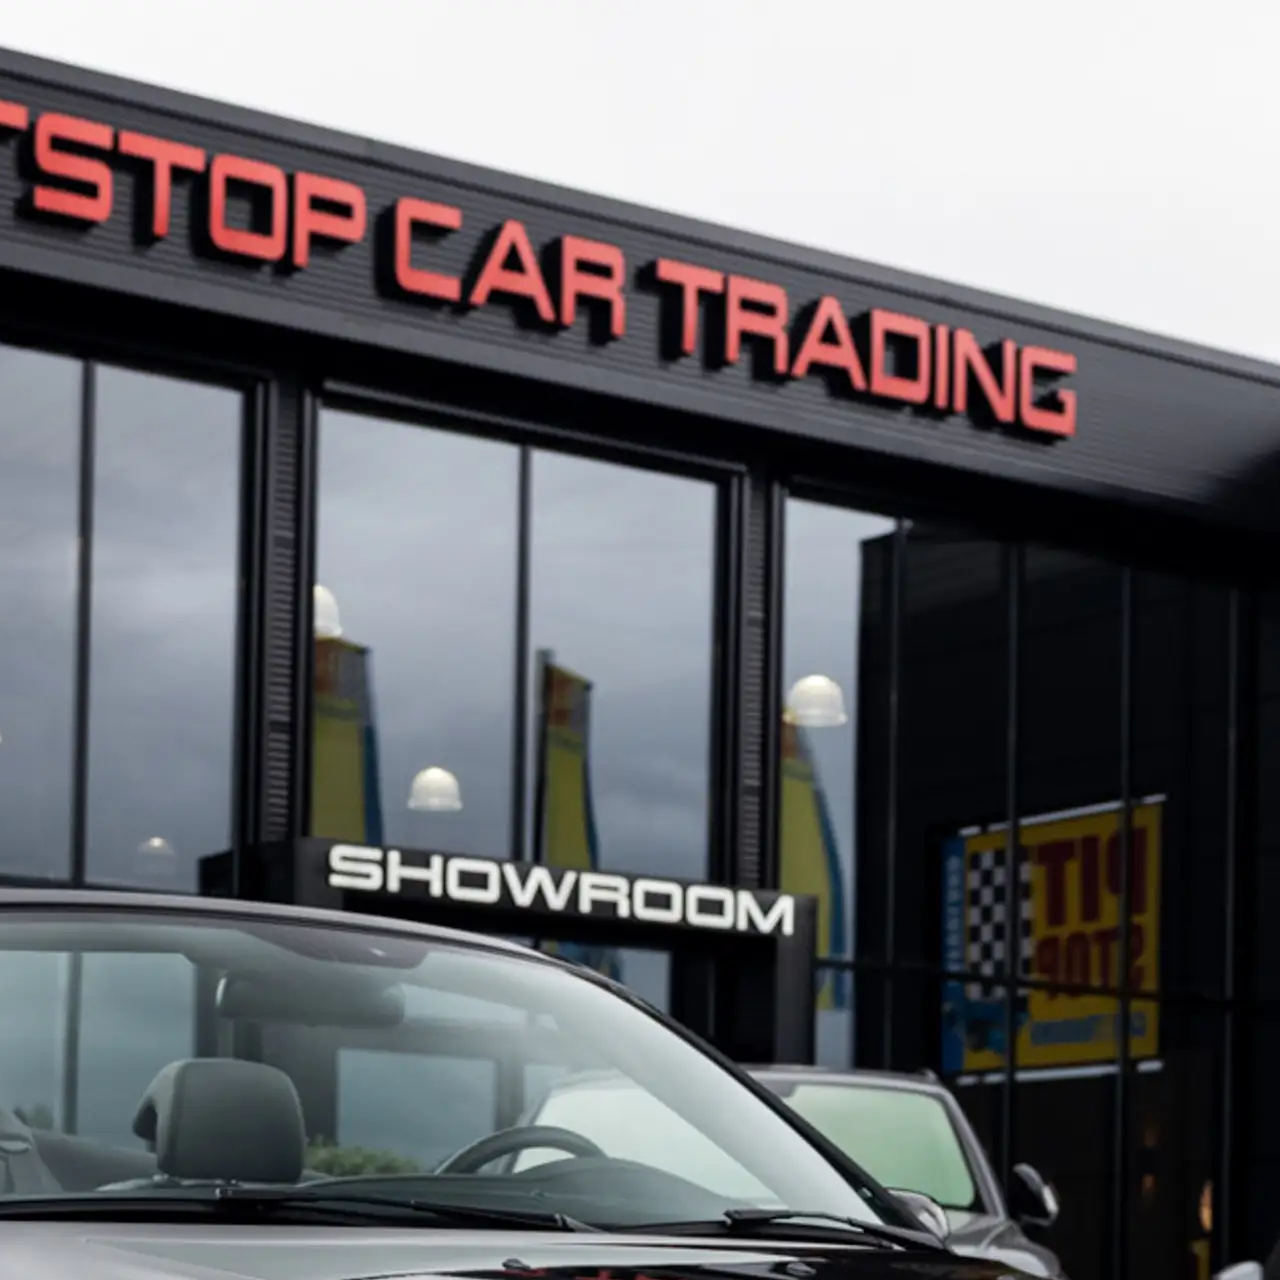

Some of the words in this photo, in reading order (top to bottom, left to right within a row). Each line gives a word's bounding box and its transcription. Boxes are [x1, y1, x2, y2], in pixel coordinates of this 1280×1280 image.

[393, 196, 626, 338] CAR
[655, 257, 1078, 437] TRADING
[328, 844, 795, 936] SHOWROOM
